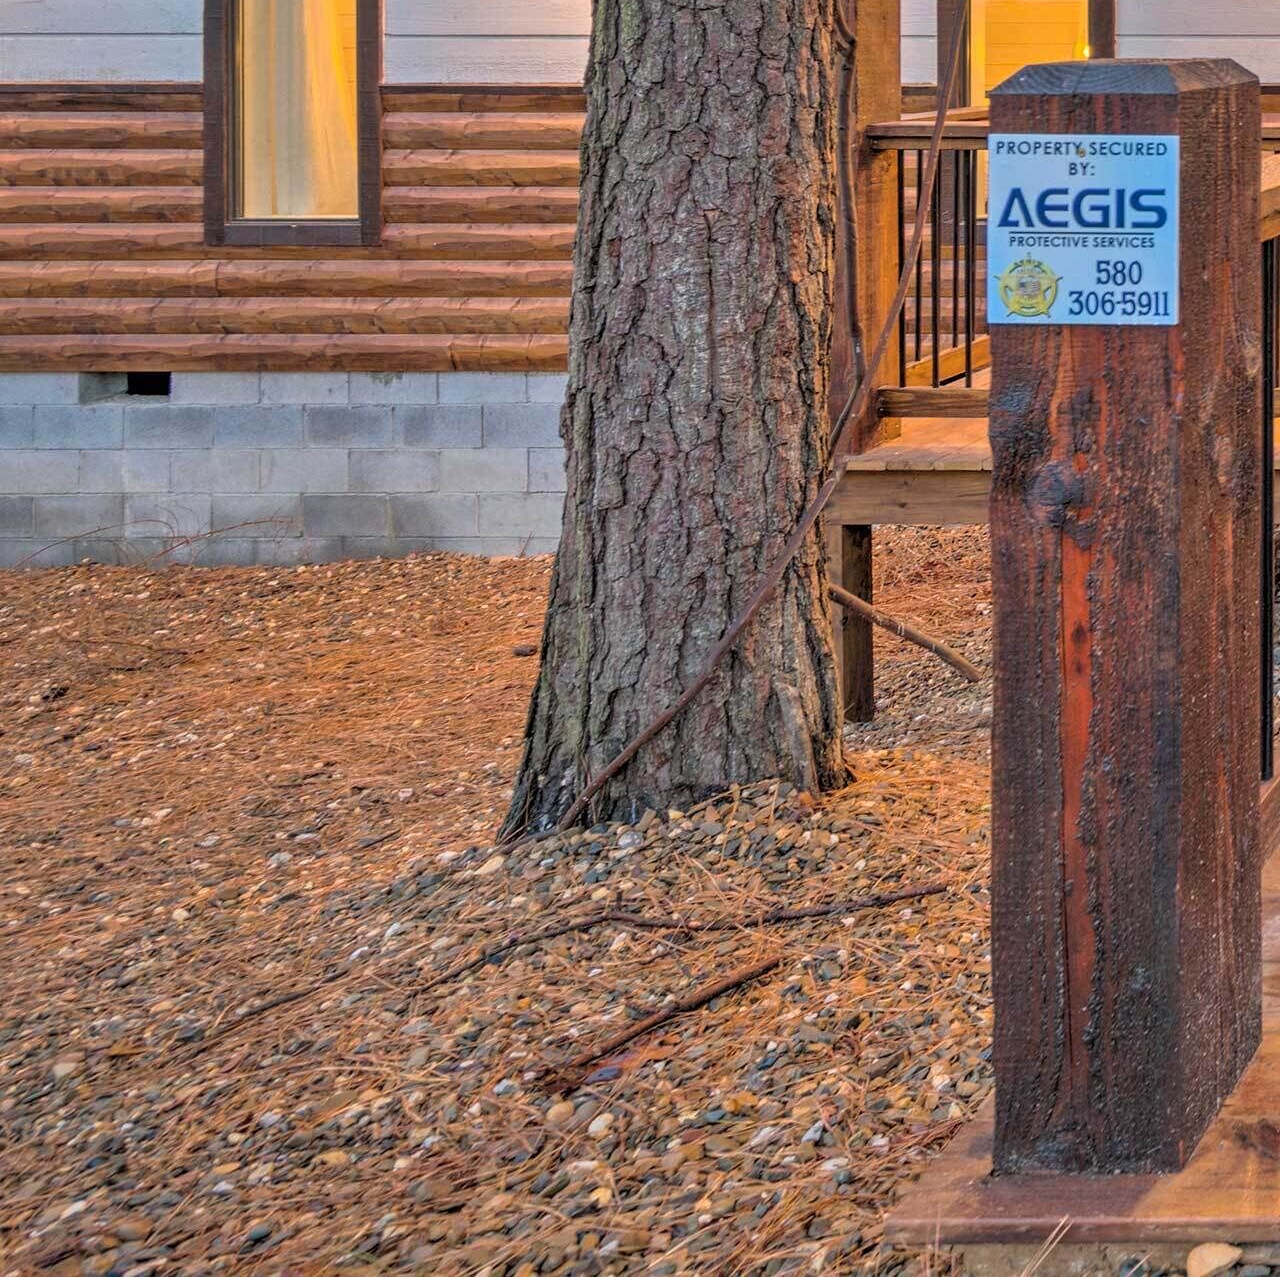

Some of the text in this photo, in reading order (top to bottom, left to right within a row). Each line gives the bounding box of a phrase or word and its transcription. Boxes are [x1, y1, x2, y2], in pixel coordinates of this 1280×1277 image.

[996, 140, 1168, 156] PROPERTY SECURED
[1068, 162, 1096, 176] BY:
[997, 187, 1168, 229] AEGIS
[1009, 235, 1156, 249] PROTECTIVE SERVICES
[1096, 260, 1143, 286] 580
[1068, 290, 1170, 317] 306-5911
